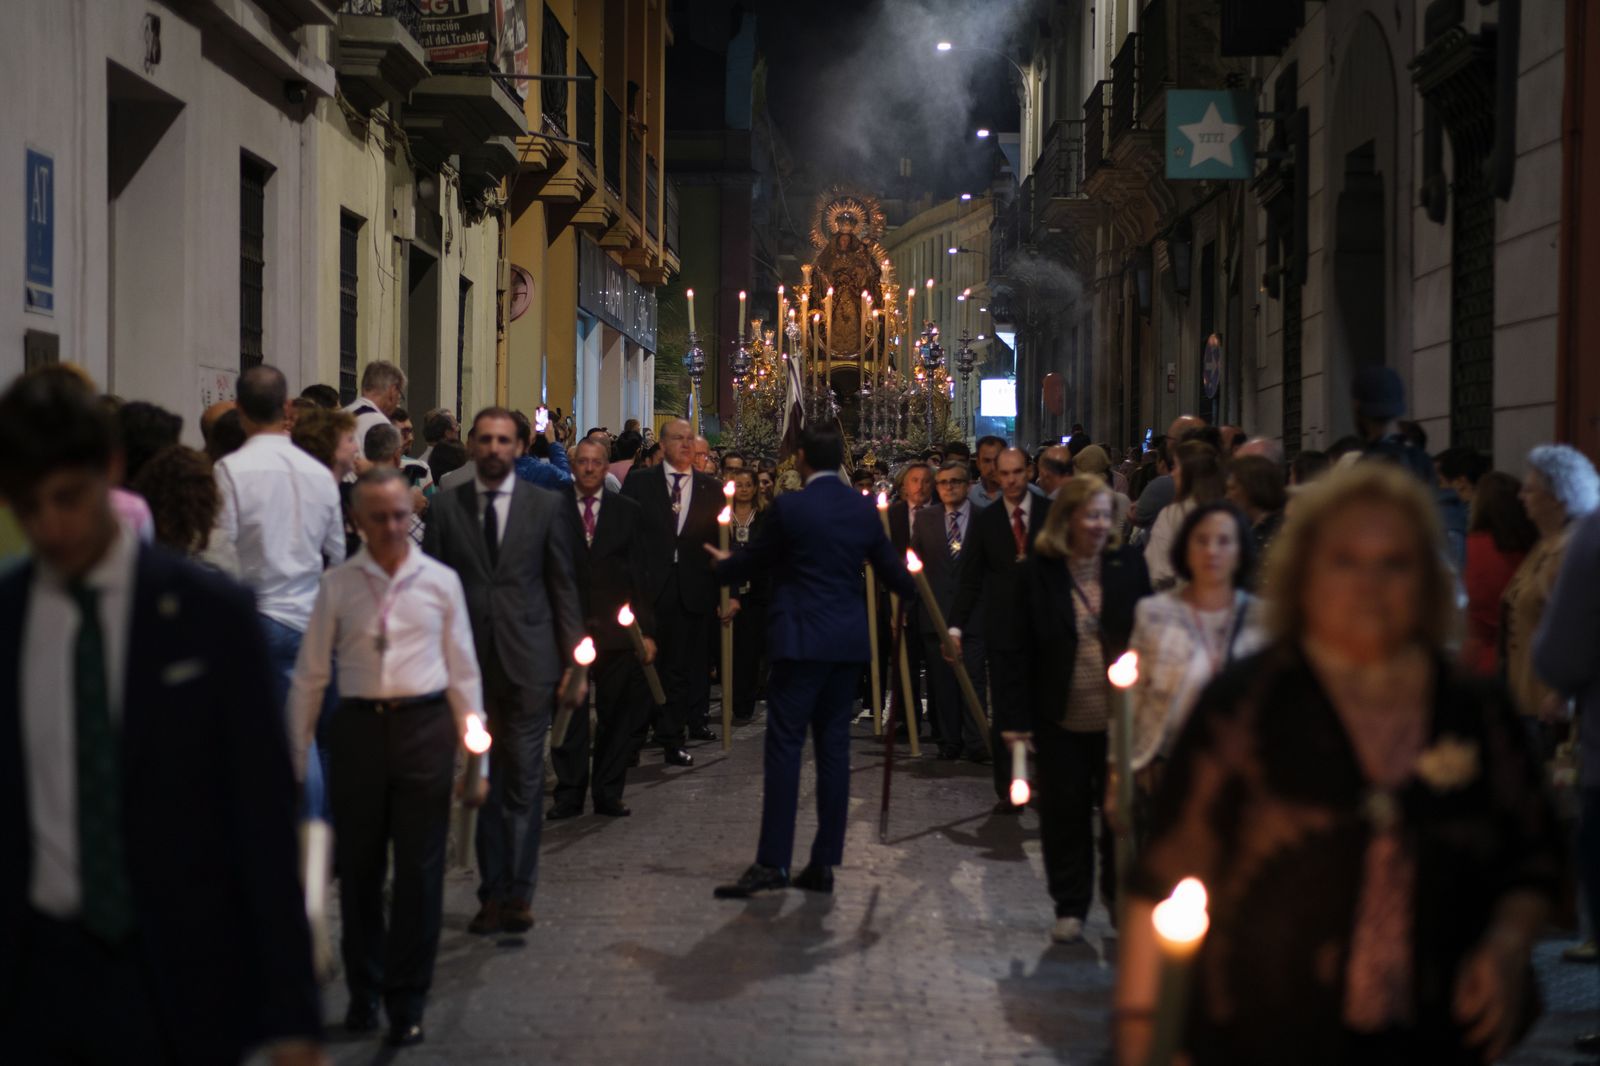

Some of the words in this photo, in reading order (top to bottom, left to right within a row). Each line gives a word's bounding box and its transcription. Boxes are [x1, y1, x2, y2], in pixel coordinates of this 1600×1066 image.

[435, 33, 449, 45] del
[451, 30, 485, 43] Trabajo
[31, 162, 49, 225] AT
